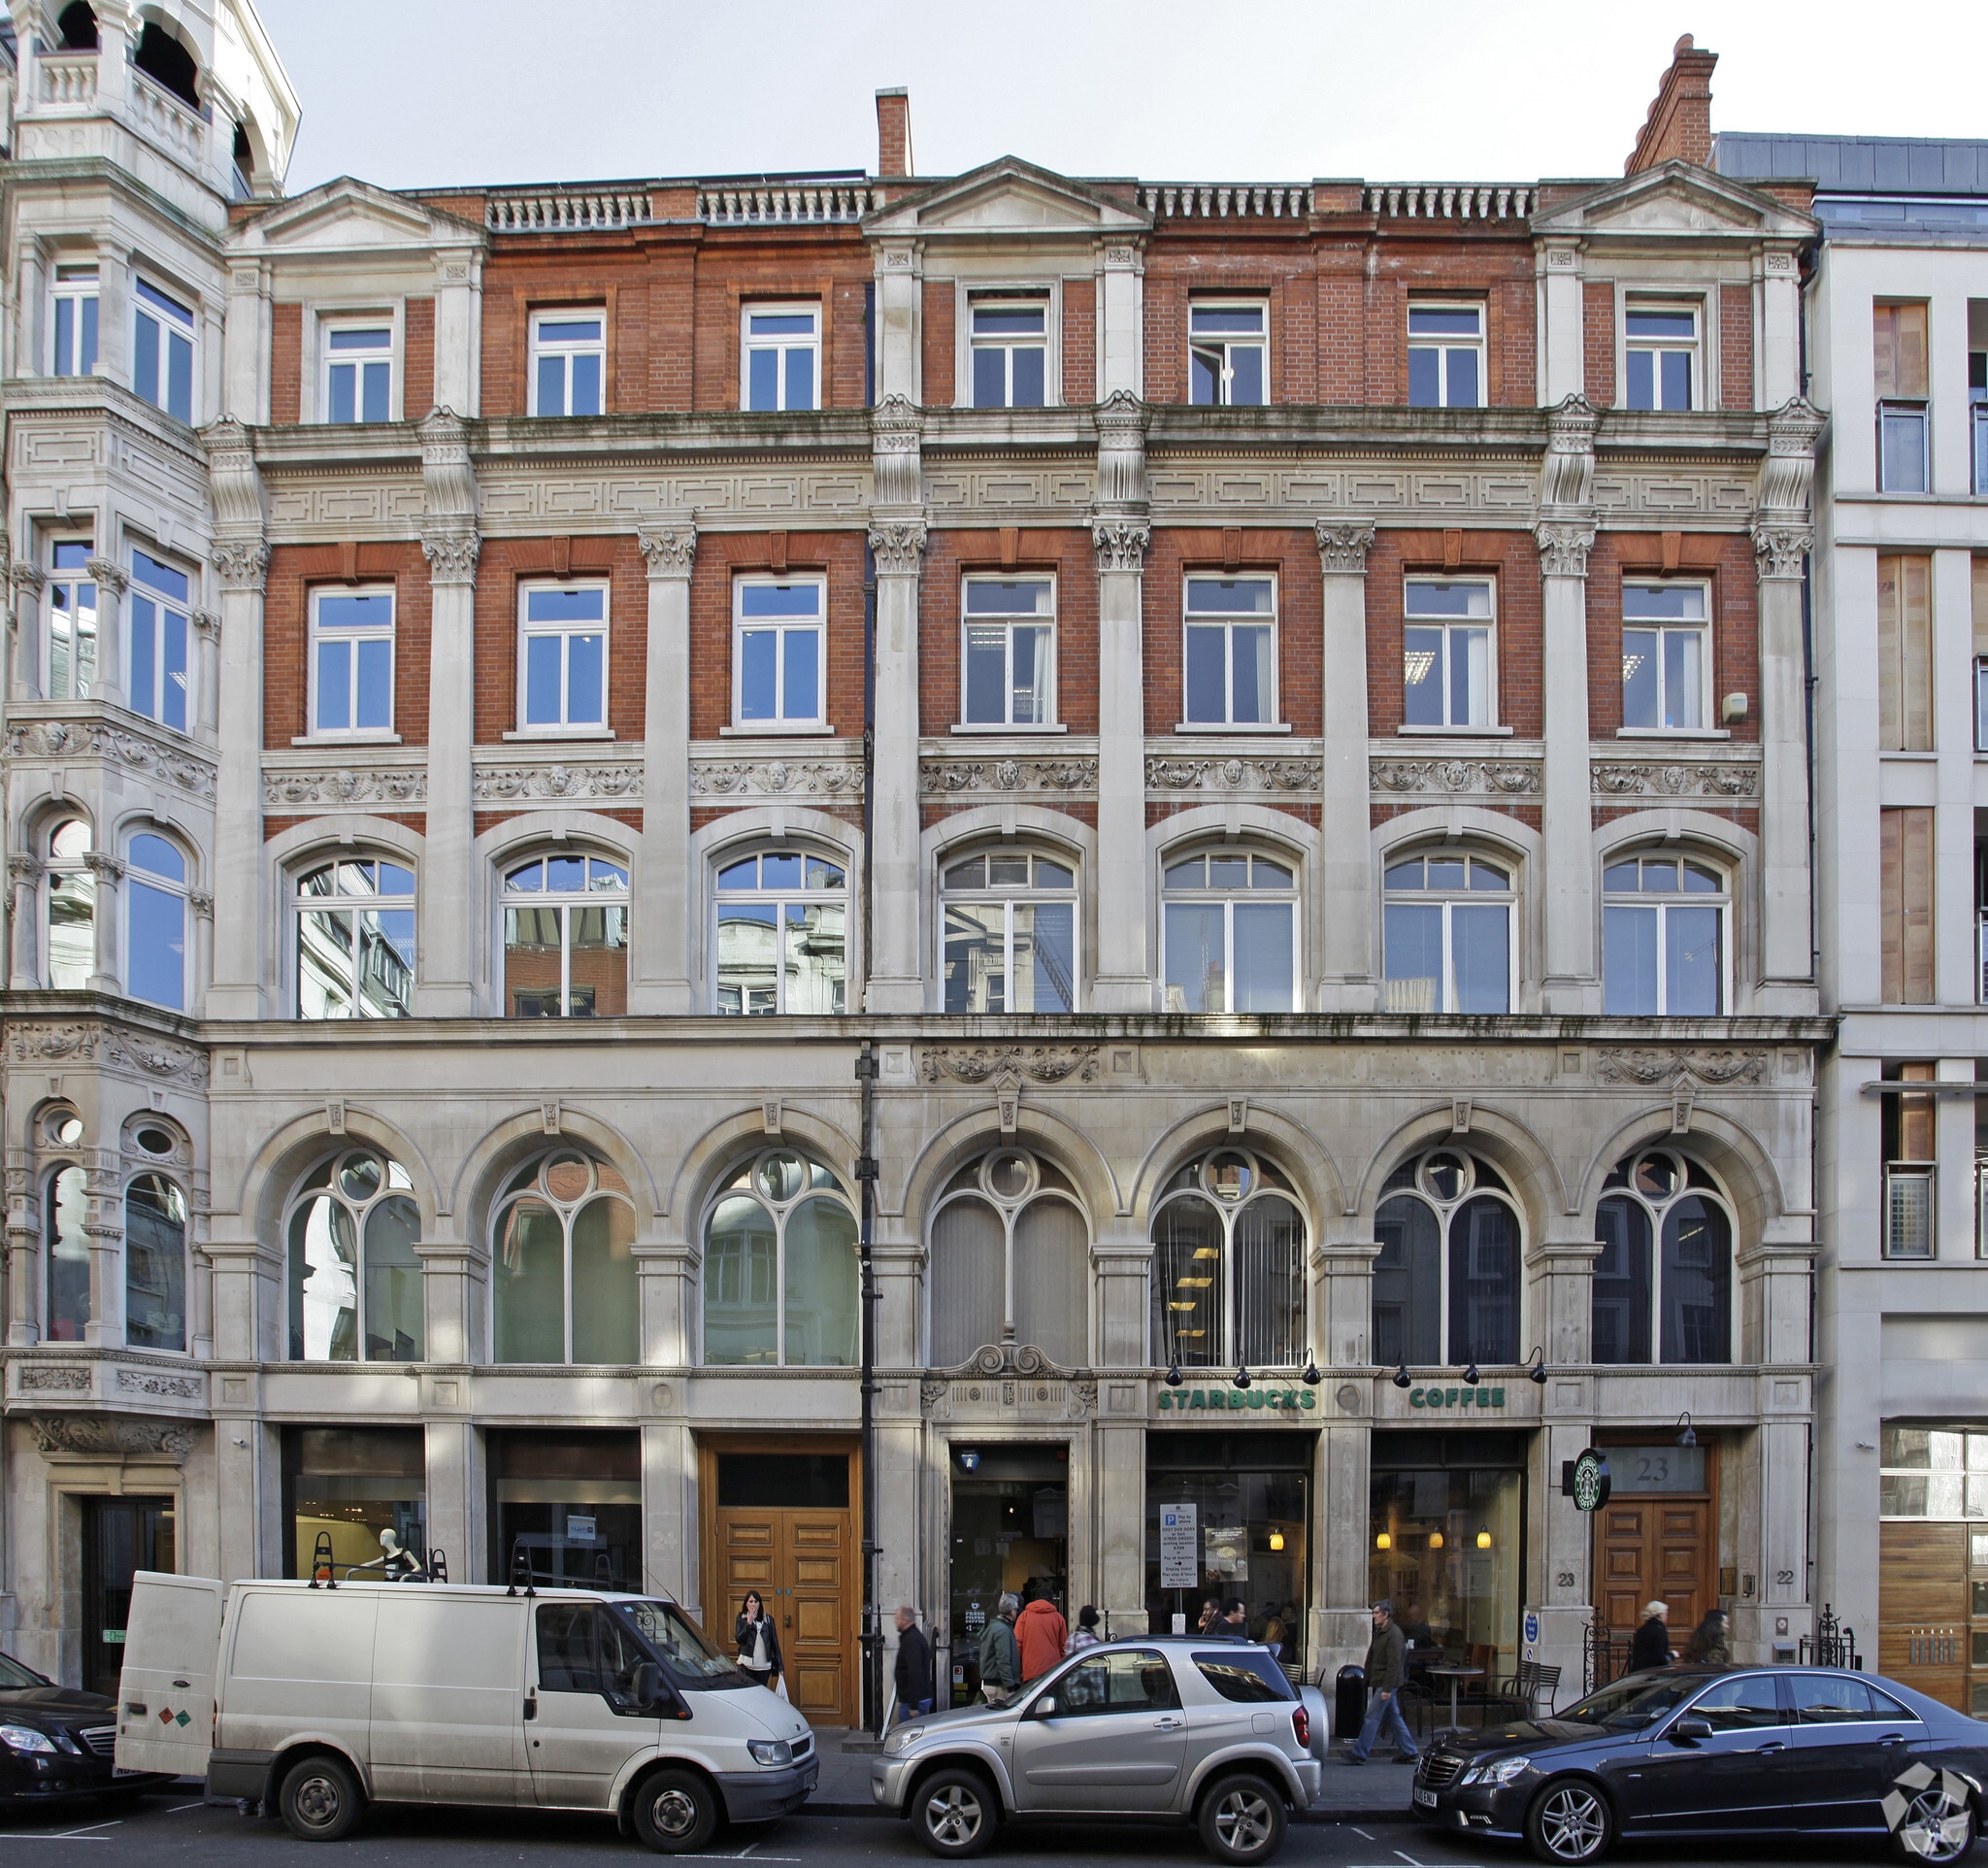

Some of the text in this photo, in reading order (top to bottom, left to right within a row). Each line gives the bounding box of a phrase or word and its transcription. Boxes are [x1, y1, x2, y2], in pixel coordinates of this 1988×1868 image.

[1158, 1387, 1506, 1410] STARBUCKS COFFEE
[1575, 1458, 1600, 1482] STARBUCKS
[1637, 1457, 1669, 1482] 23
[1578, 1494, 1596, 1509] COFFEE
[1558, 1572, 1575, 1587] 23
[1776, 1570, 1795, 1585] 22
